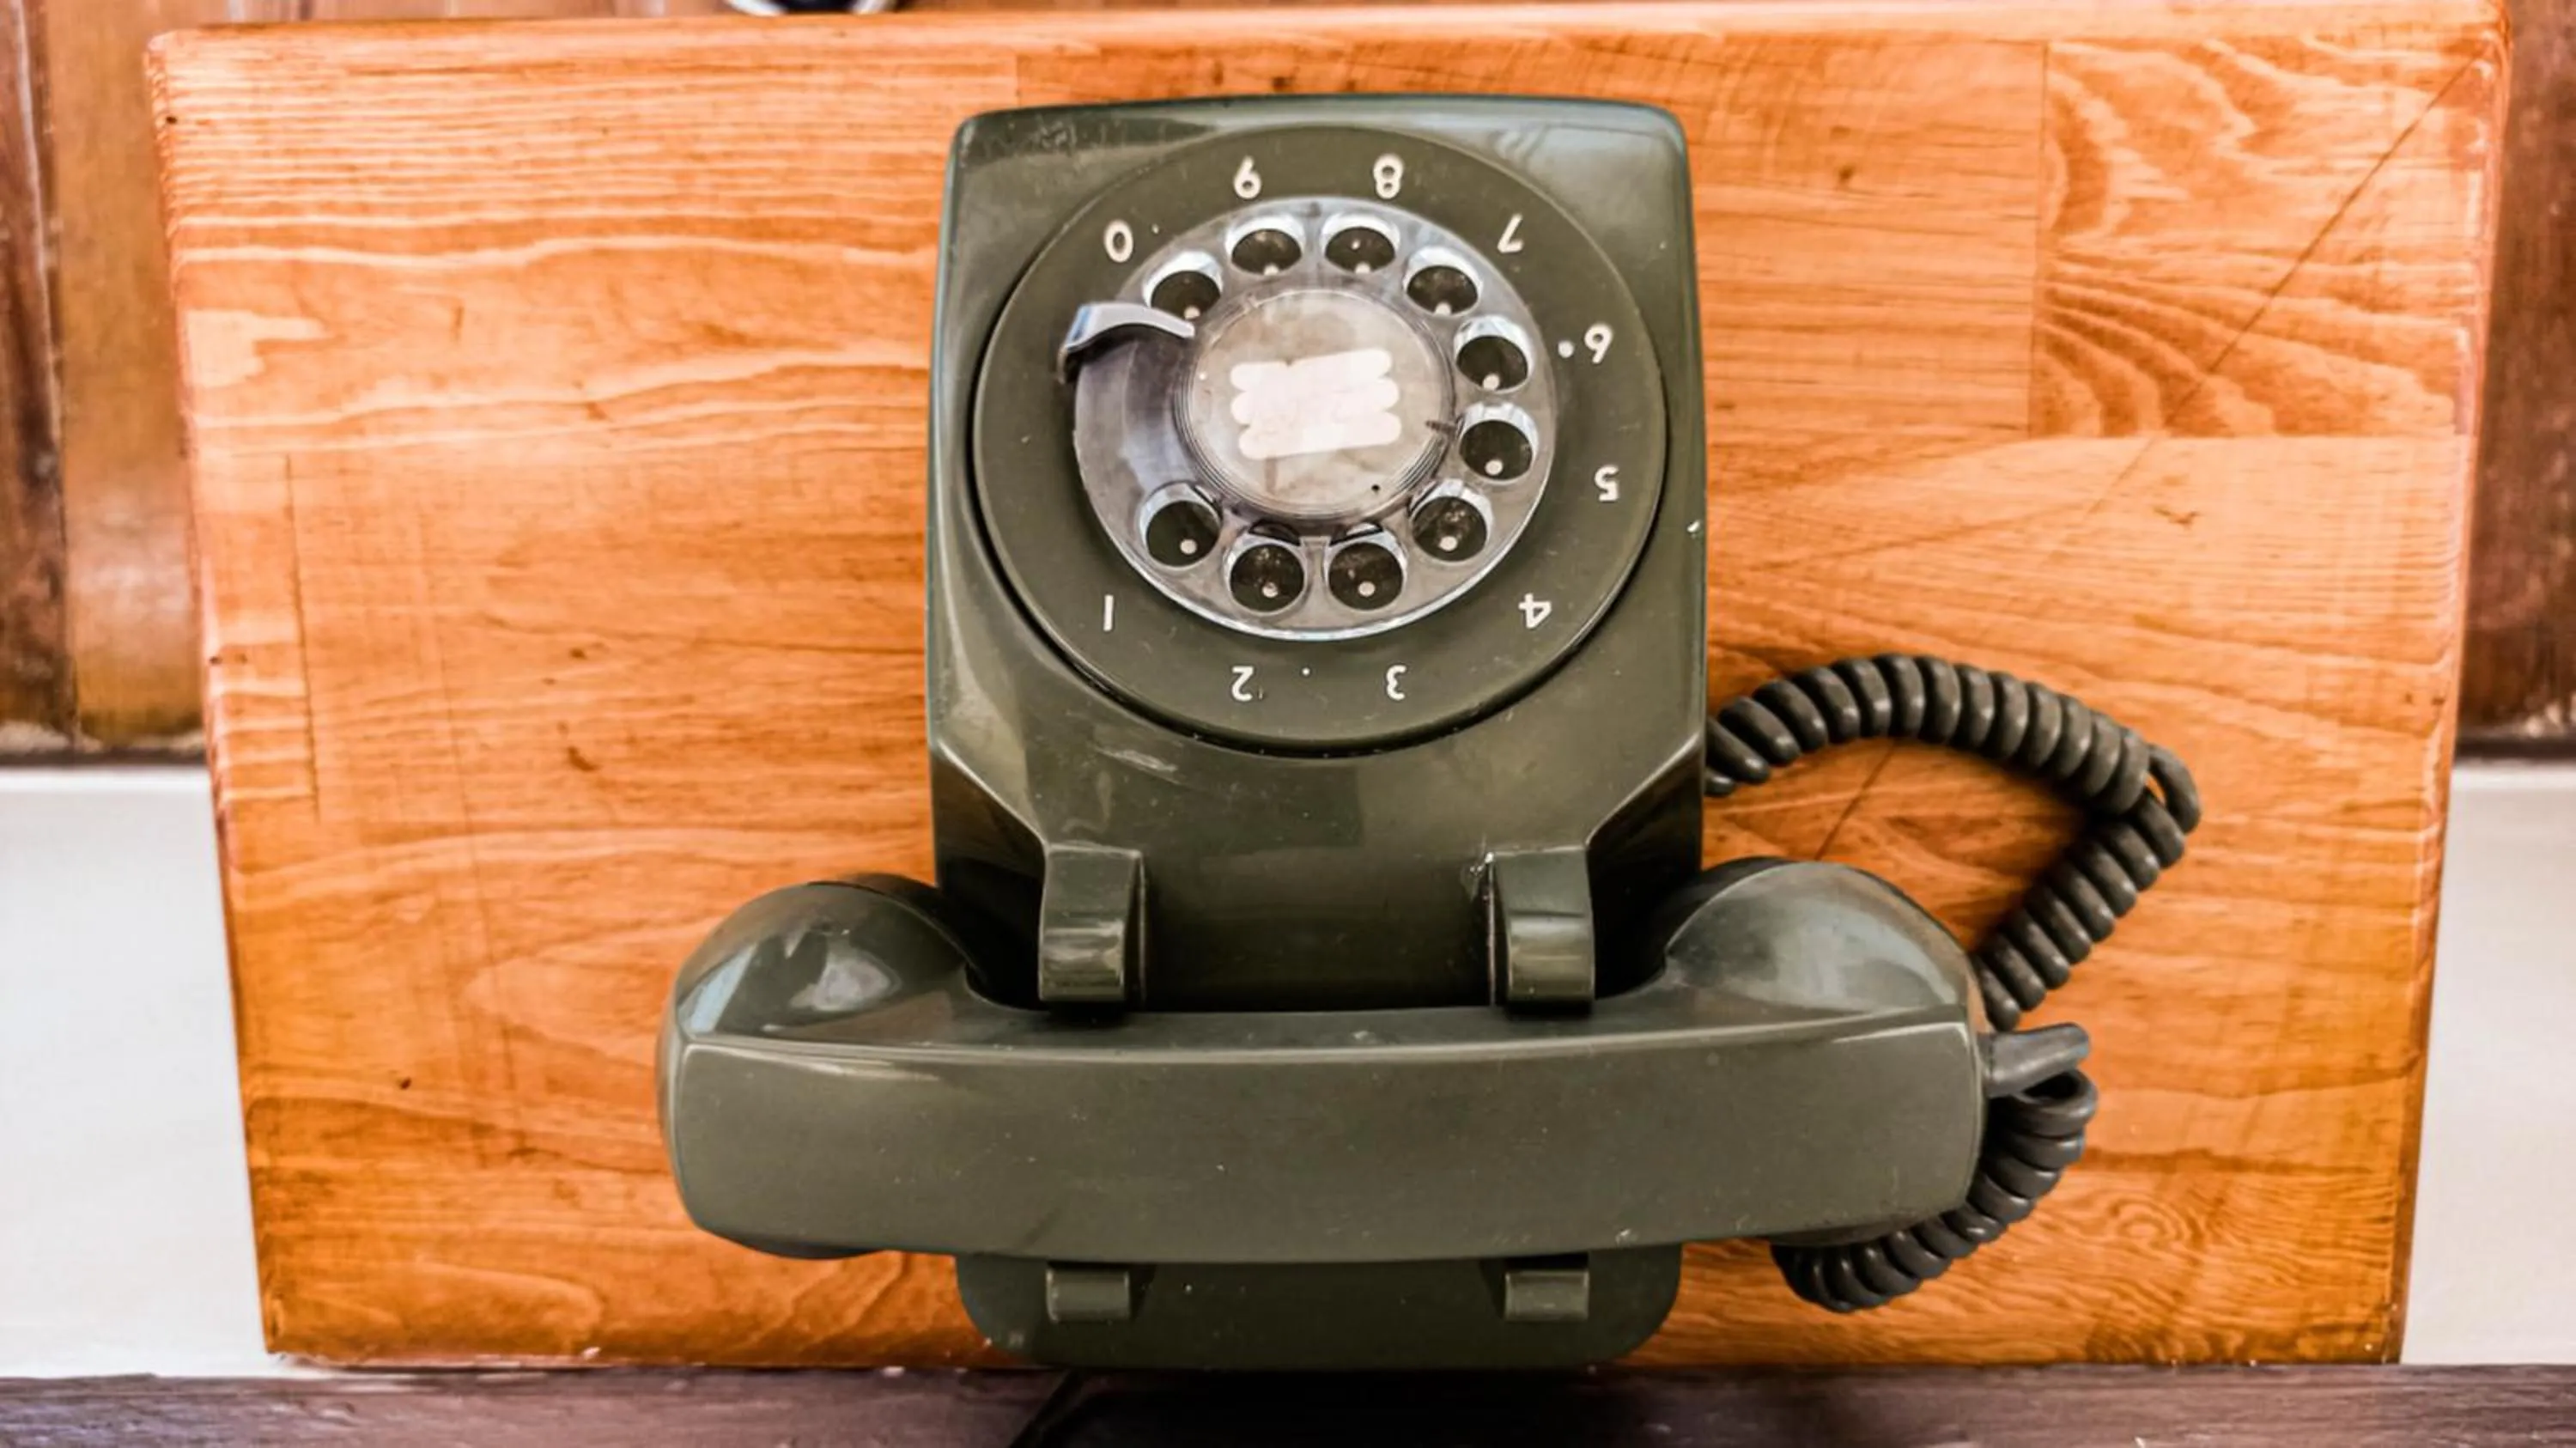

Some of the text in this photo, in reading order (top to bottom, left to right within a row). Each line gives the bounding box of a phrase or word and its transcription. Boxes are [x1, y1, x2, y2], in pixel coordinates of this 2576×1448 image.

[1234, 155, 1262, 199] 9
[1372, 153, 1405, 199] 8
[1103, 219, 1133, 263] 0
[1497, 213, 1523, 253] 7
[1583, 322, 1614, 364] 6
[1594, 465, 1619, 502] 5
[1103, 594, 1115, 632] 1
[1517, 593, 1552, 630] 4
[1230, 666, 1255, 702] 2
[1385, 665, 1407, 701] 3
